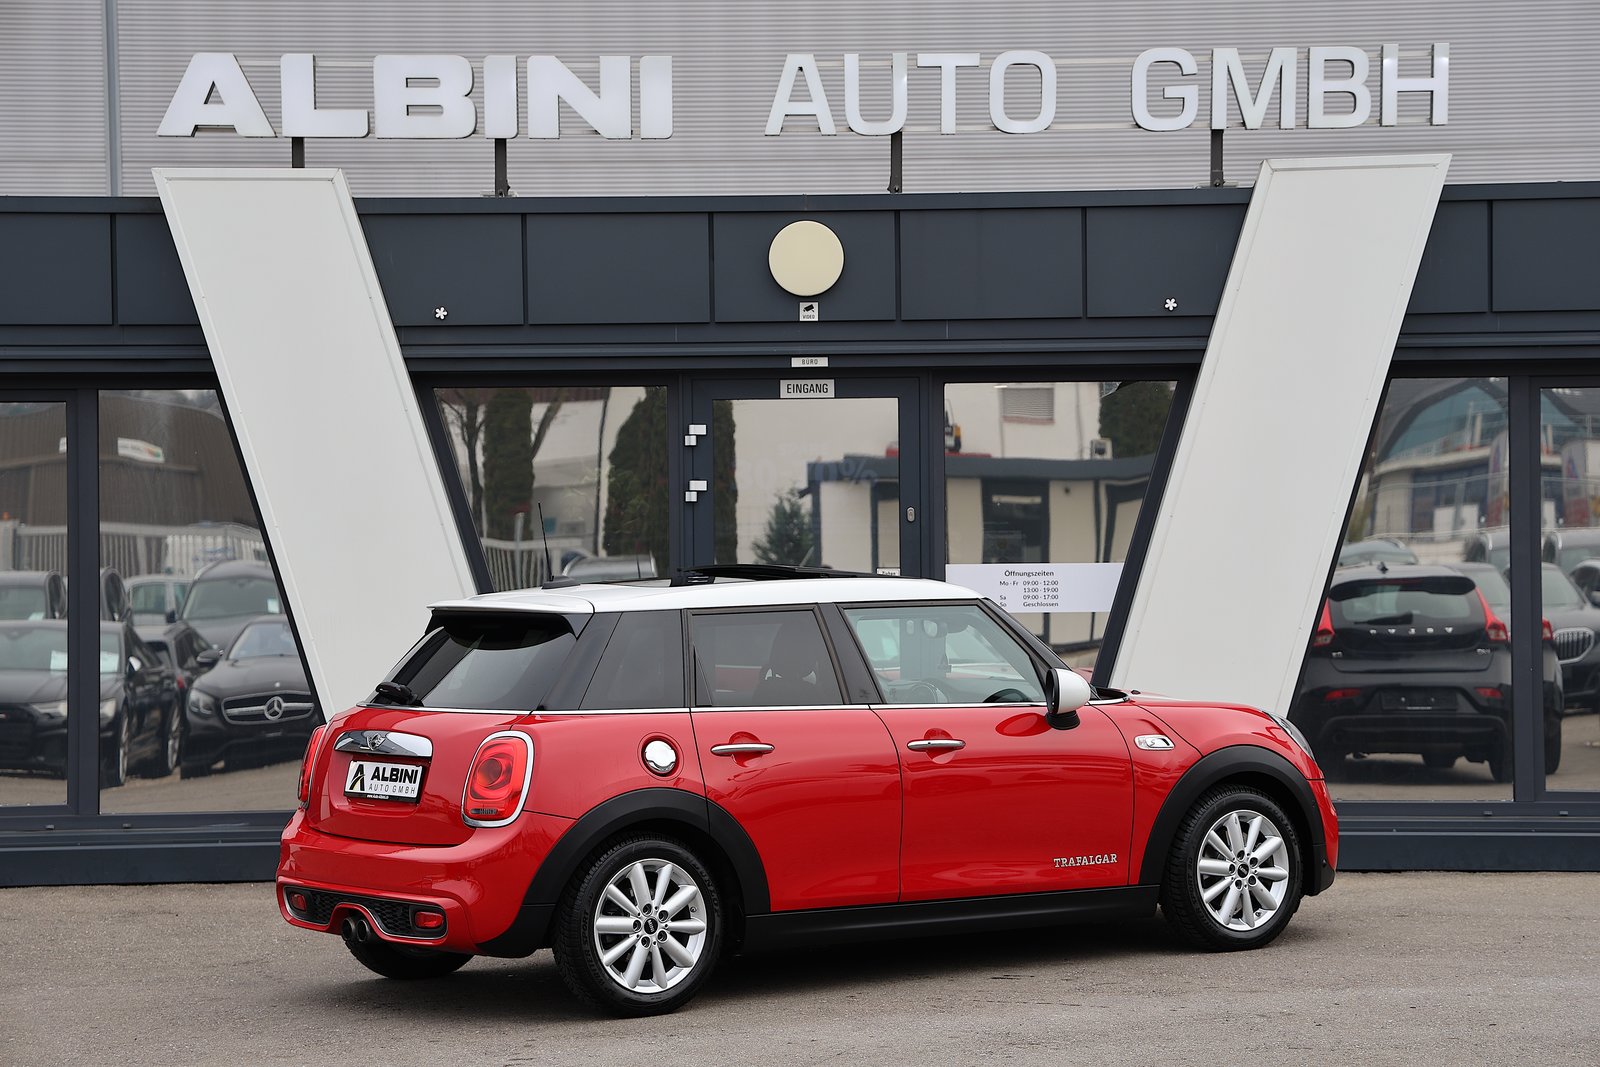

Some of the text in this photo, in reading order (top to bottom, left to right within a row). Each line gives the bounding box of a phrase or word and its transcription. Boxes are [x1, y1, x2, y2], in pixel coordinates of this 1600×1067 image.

[156, 42, 1450, 139] ALBINI AUTO GMBH
[786, 383, 829, 394] EINGANG
[1004, 570, 1054, 578] Öffnungszeiten
[370, 766, 419, 784] ALBINI
[368, 783, 416, 795] AUTO GMBH
[1053, 853, 1118, 868] TRAFALGAR
